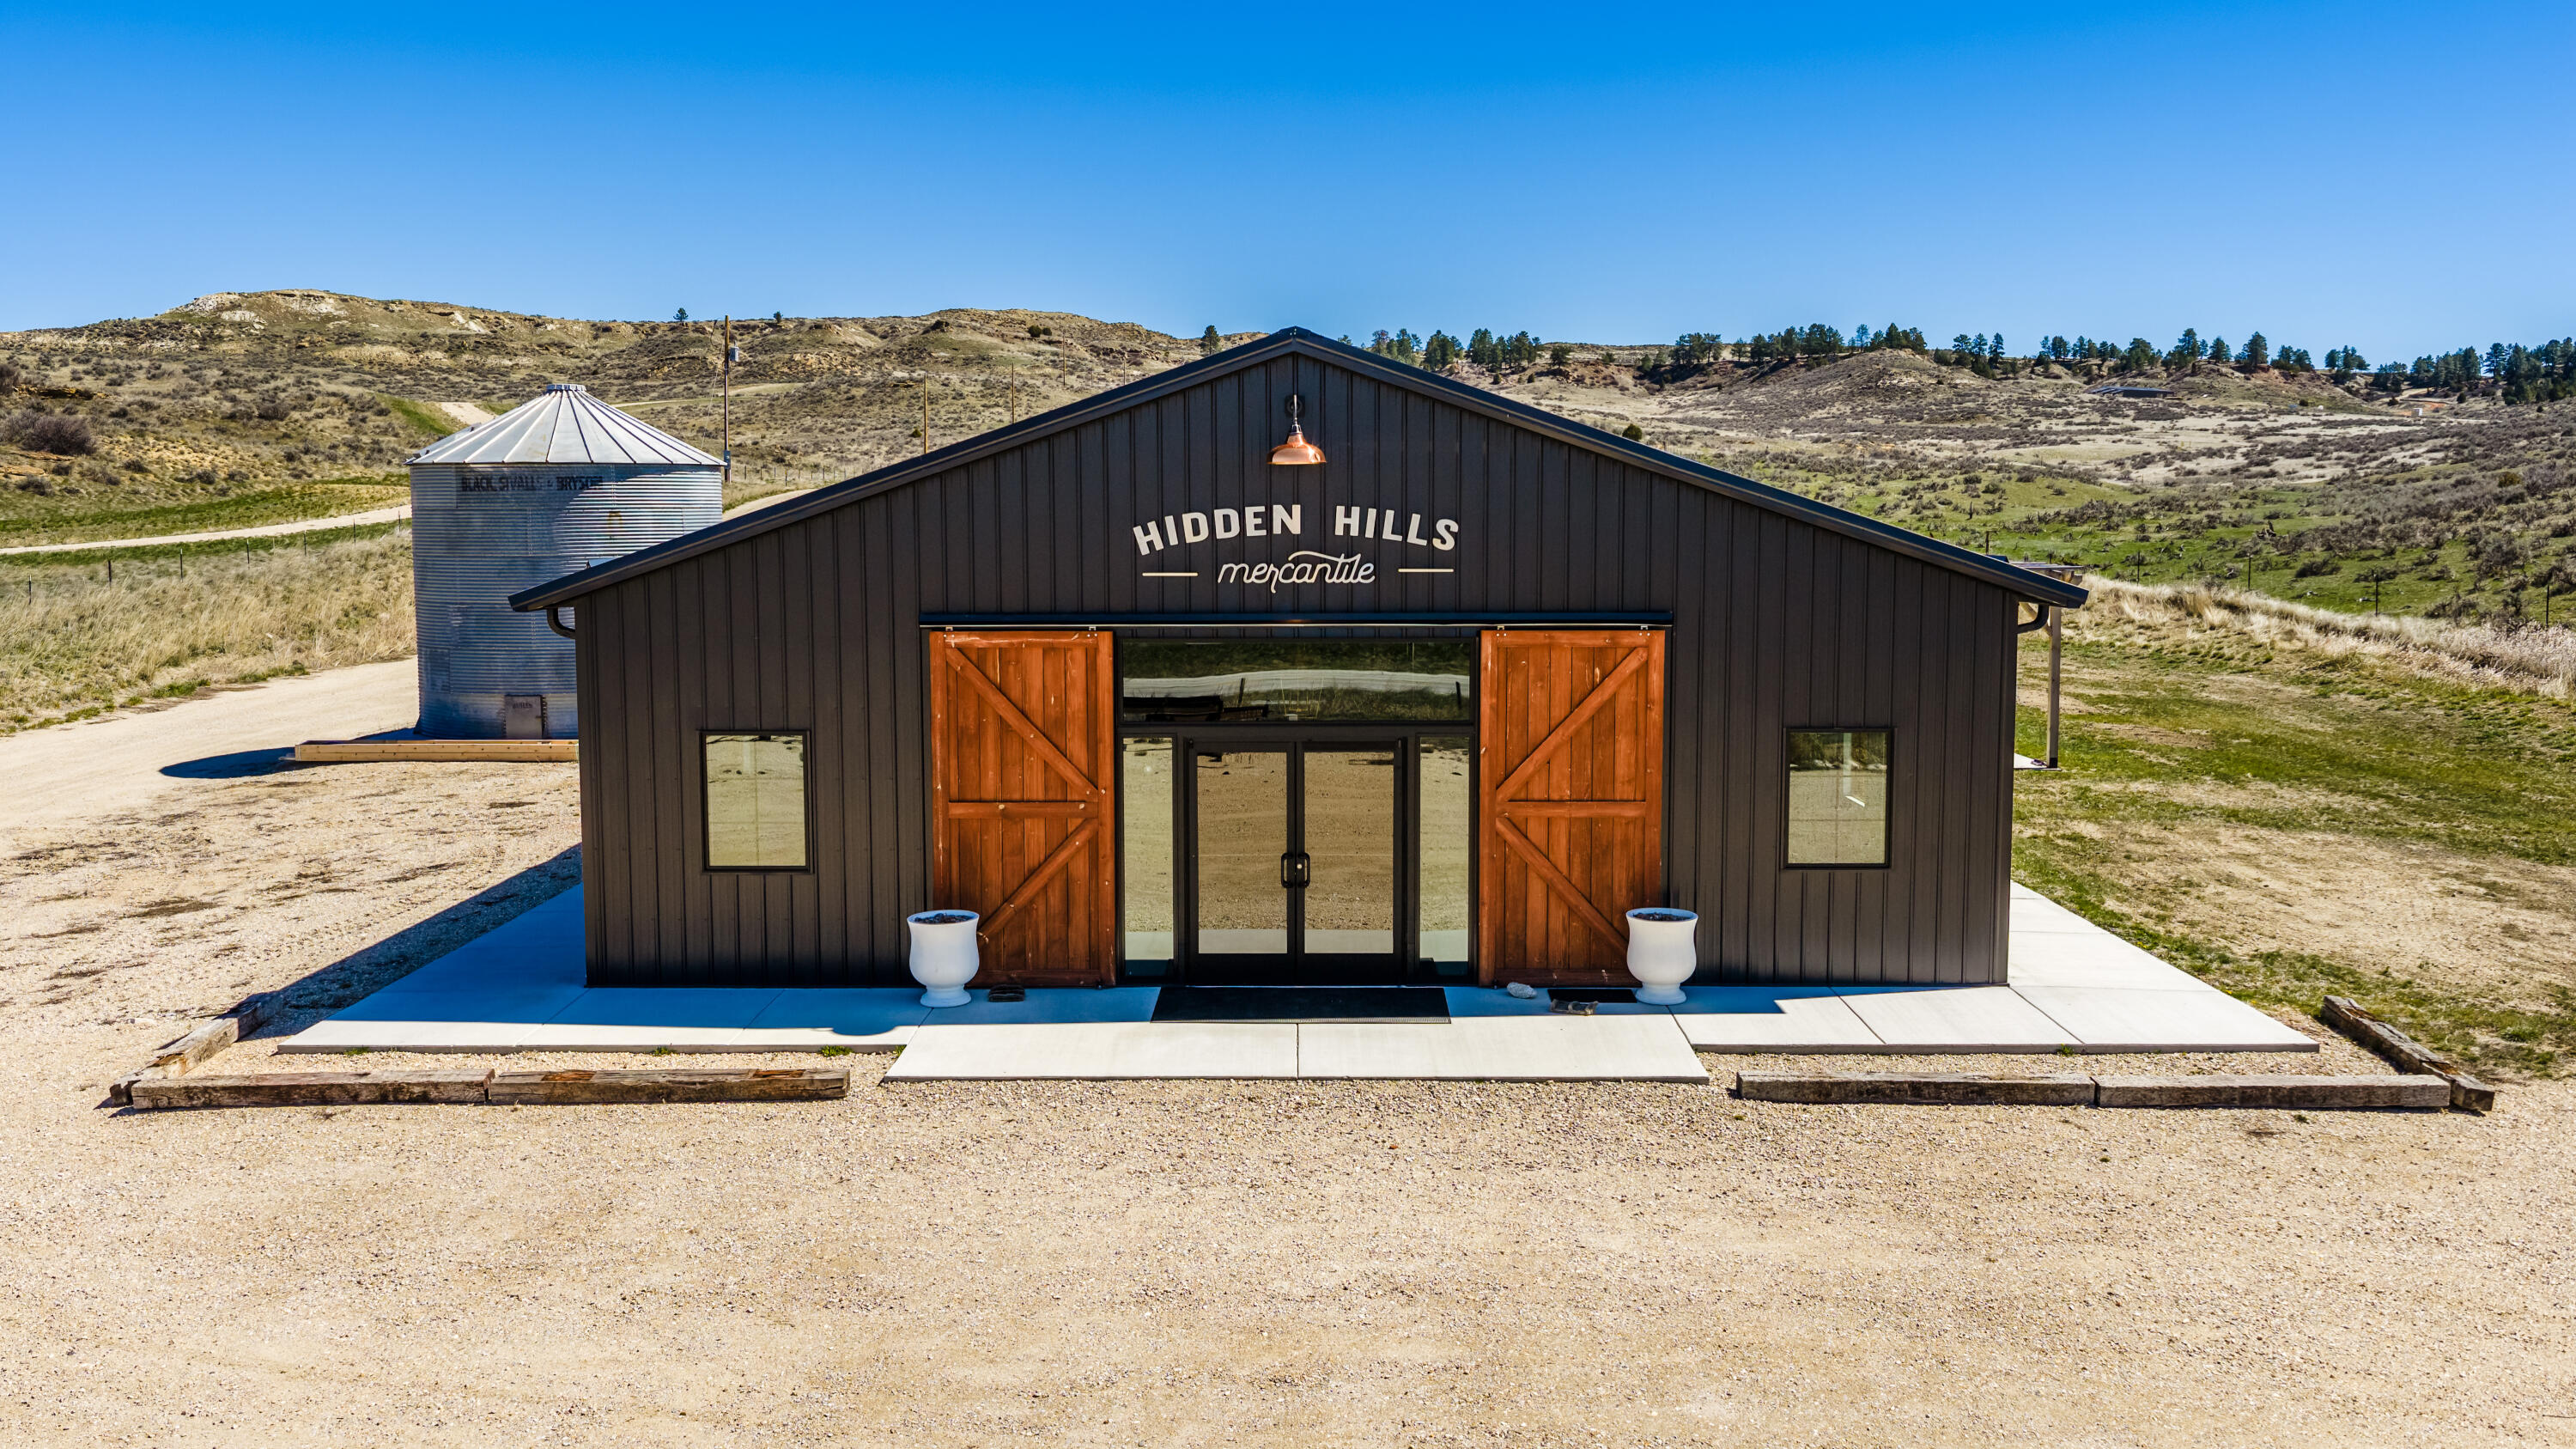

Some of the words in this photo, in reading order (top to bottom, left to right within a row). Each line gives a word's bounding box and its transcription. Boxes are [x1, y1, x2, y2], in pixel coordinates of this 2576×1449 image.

[1133, 504, 1302, 556] HIDDEN
[1334, 505, 1459, 551] HILLS
[1218, 551, 1376, 594] mercantile
